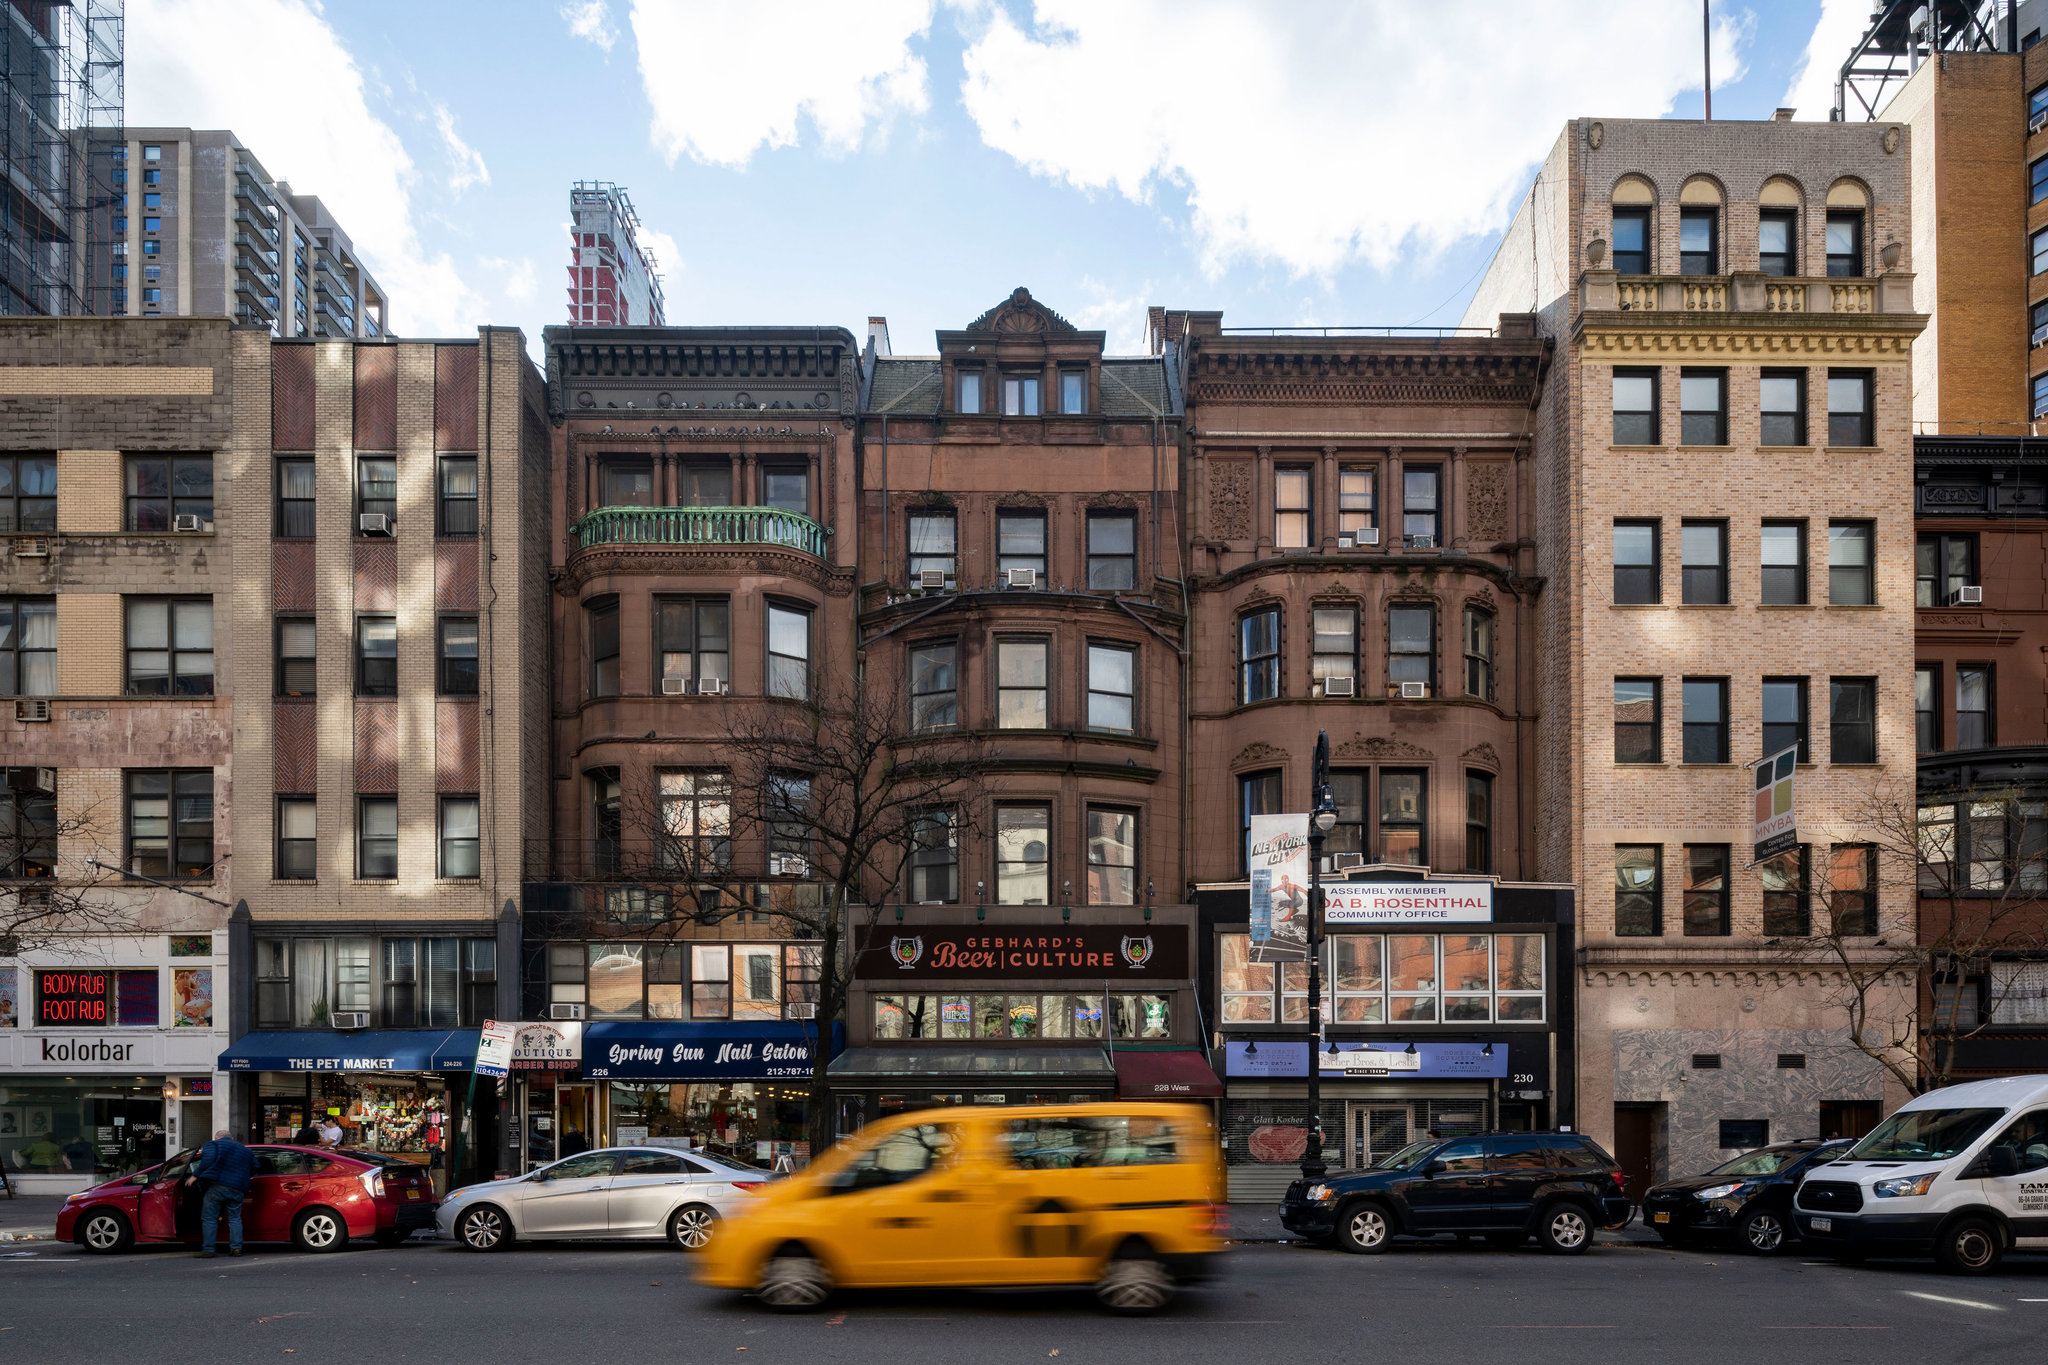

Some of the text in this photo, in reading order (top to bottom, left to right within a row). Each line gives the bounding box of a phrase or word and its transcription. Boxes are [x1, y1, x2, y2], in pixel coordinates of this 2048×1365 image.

[1755, 815, 1793, 839] MNYBA
[1252, 840, 1280, 856] NEW
[1278, 835, 1307, 852] YORK
[1330, 887, 1446, 895] ASSEMBLYMEMBER
[1350, 898, 1367, 909] B.
[1374, 898, 1488, 909] ROSENTHAL
[1328, 911, 1401, 919] COMMUNITY
[930, 941, 1114, 968] Beer CULTURE
[43, 974, 105, 995] BODY RUB
[43, 1000, 105, 1020] FOOT RUB
[483, 1038, 489, 1046] 2
[42, 1038, 133, 1061] kolorbar
[514, 1049, 572, 1058] OUTIQUE
[609, 1043, 808, 1065] Spring Sun Nail Salon
[288, 1058, 394, 1069] THE PET MARKET
[509, 1061, 578, 1070] ARBER SHOP
[1353, 1053, 1377, 1067] Bros.
[1389, 1053, 1418, 1067] Leslie
[767, 1068, 815, 1076] 212-787-16
[1513, 1074, 1533, 1083] 230
[1154, 1084, 1190, 1092] 228 West
[1253, 1115, 1304, 1123] Glatt Kosher
